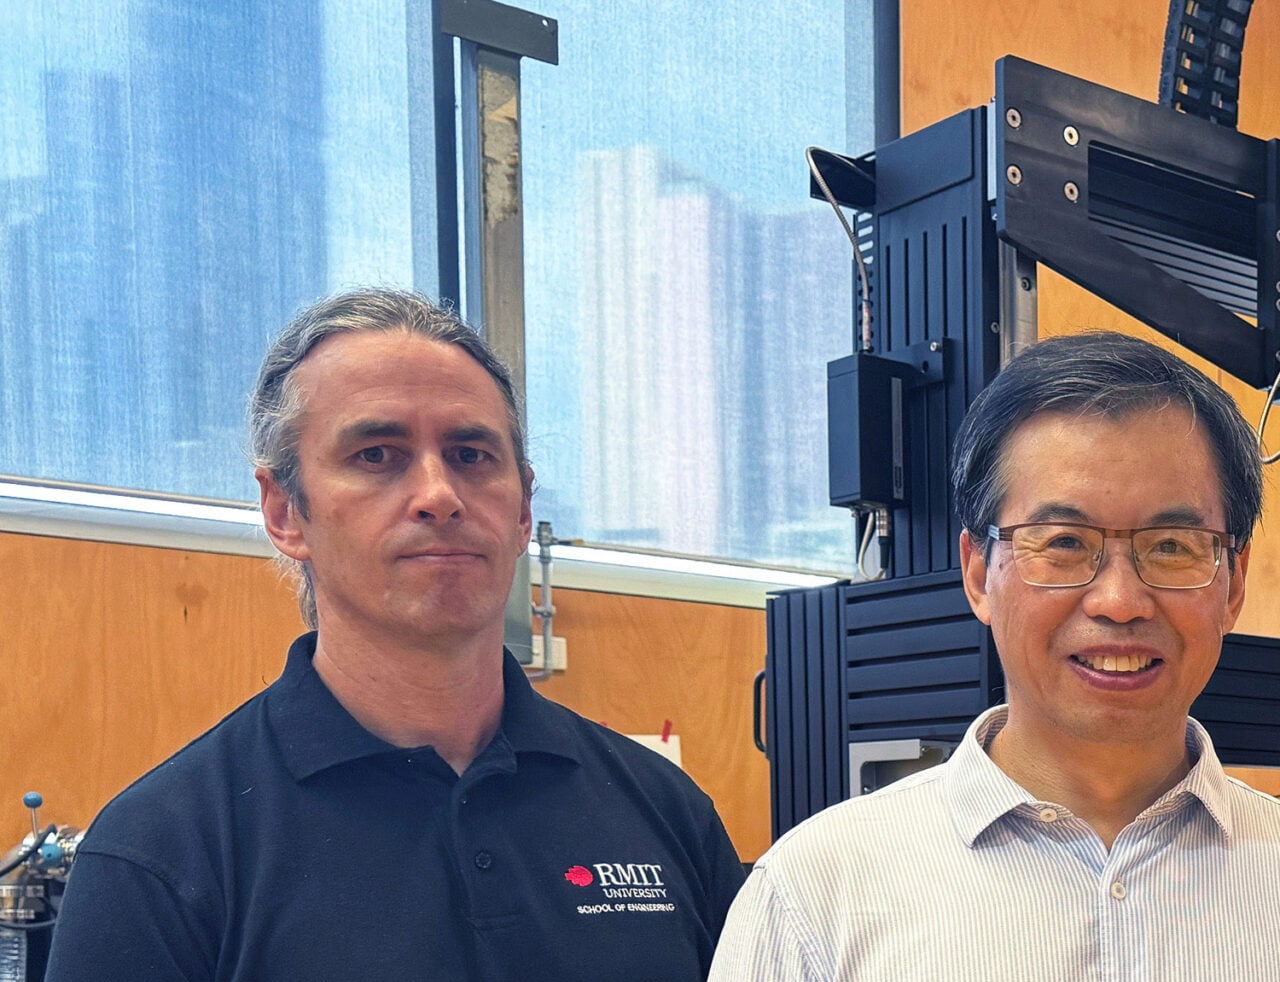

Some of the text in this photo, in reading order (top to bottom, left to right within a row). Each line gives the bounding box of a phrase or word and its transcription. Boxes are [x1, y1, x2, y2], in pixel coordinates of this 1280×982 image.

[593, 863, 664, 886] RMIT
[602, 888, 667, 898] UNIVERSITY
[577, 903, 675, 914] SCHOOL OF ENGINEERING
